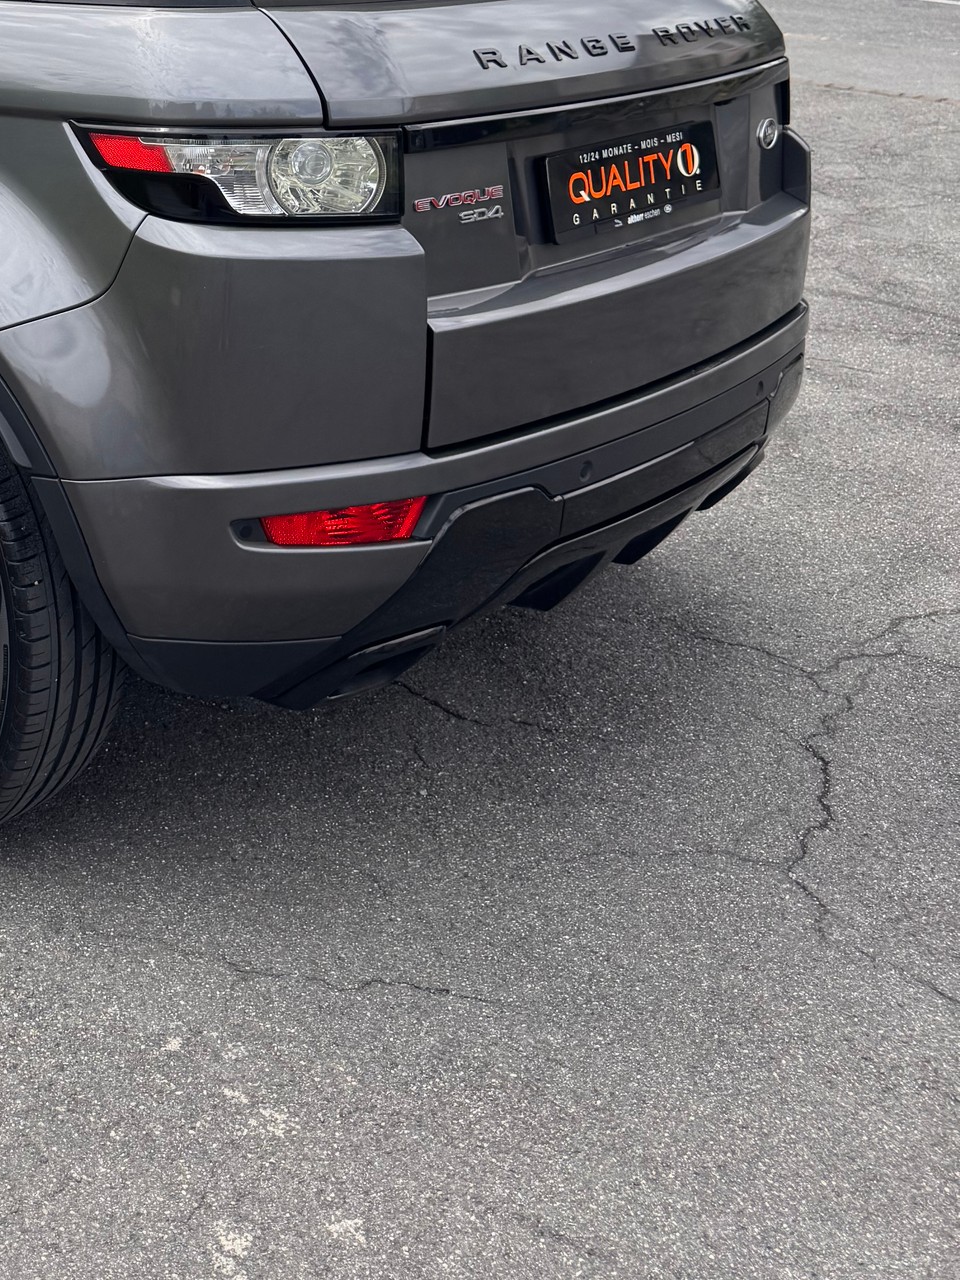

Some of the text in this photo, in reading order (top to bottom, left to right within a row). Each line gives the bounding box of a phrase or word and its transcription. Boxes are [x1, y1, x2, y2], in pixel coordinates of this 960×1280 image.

[472, 14, 751, 70] RANGE ROVER
[579, 151, 600, 164] 12/24
[602, 143, 633, 159] MONATE
[640, 137, 659, 150] MOIS
[666, 131, 683, 143] MESI
[568, 149, 674, 205] QUALITY
[413, 185, 503, 212] EVOQUE
[458, 205, 504, 224] SD4
[573, 179, 704, 226] GARANTIE
